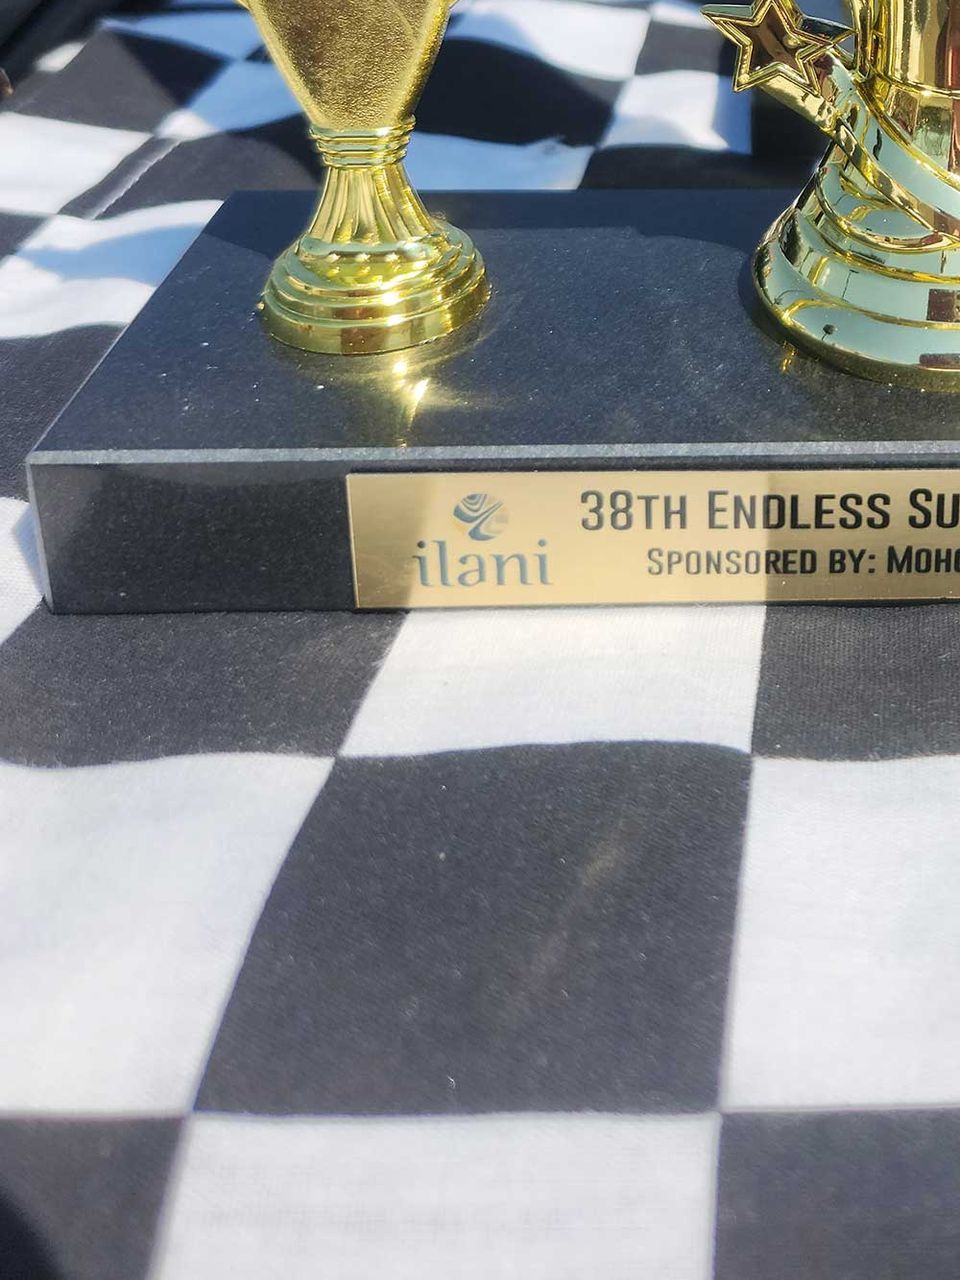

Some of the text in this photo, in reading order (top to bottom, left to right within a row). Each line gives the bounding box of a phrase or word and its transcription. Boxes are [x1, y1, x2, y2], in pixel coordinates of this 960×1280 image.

[580, 489, 687, 531] 38TH
[707, 489, 891, 530] ENDLESS
[411, 539, 554, 588] ilani
[647, 547, 818, 576] SPONSORED
[828, 548, 876, 575] BY:
